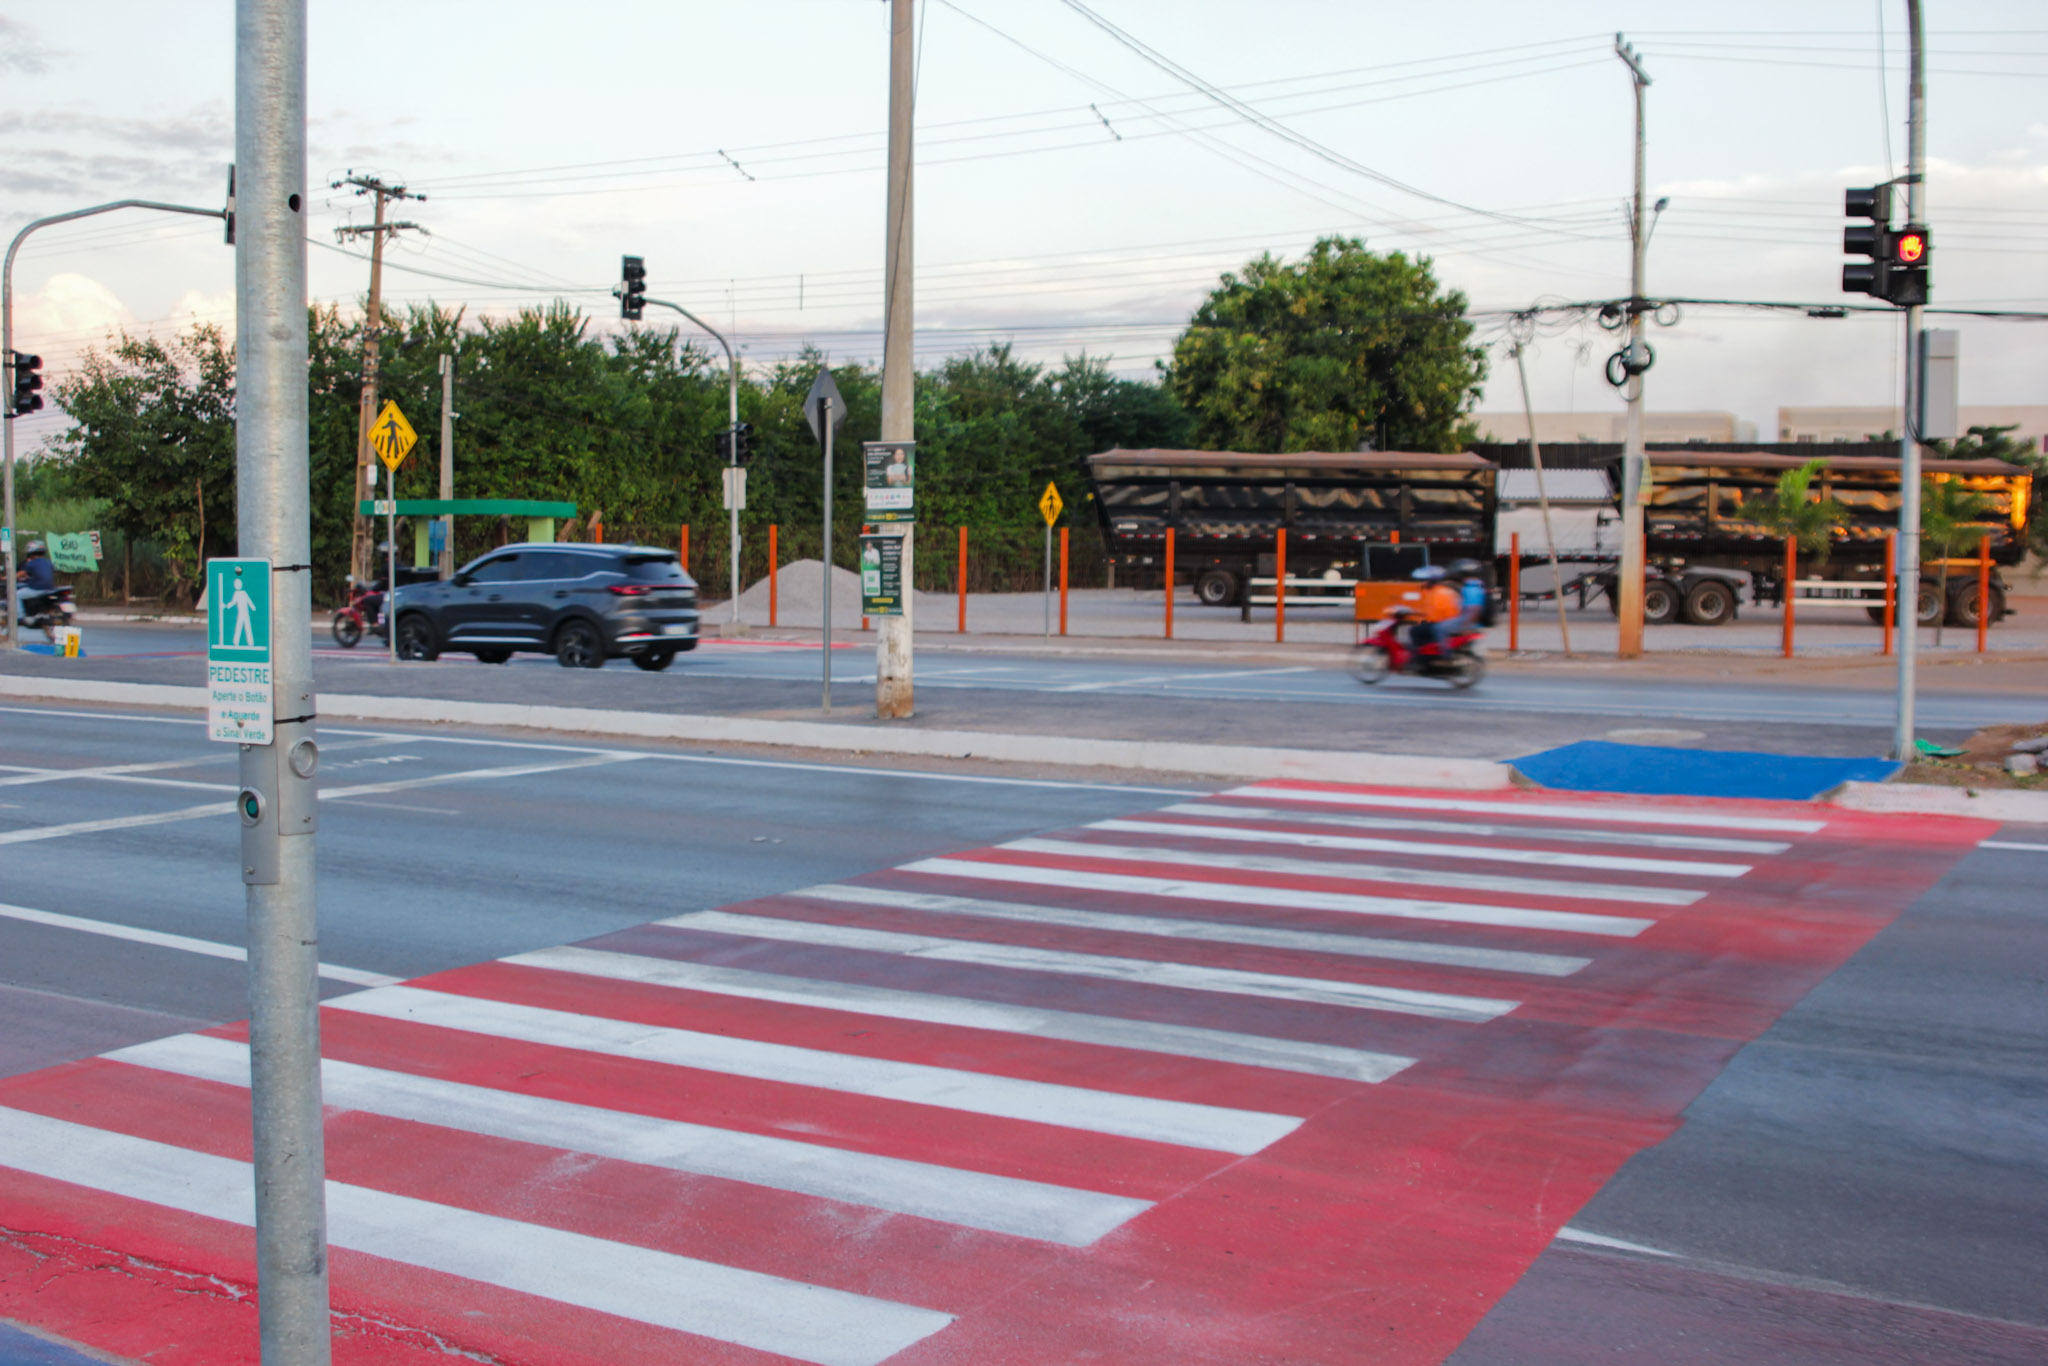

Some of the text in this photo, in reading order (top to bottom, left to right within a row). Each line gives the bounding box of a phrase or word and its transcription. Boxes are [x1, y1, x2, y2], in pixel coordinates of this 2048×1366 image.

[209, 666, 269, 684] PEDESTRE
[213, 691, 236, 702] Aperte
[228, 709, 260, 721] Aguarde
[223, 727, 241, 738] Sinal
[244, 728, 265, 739] Verde
